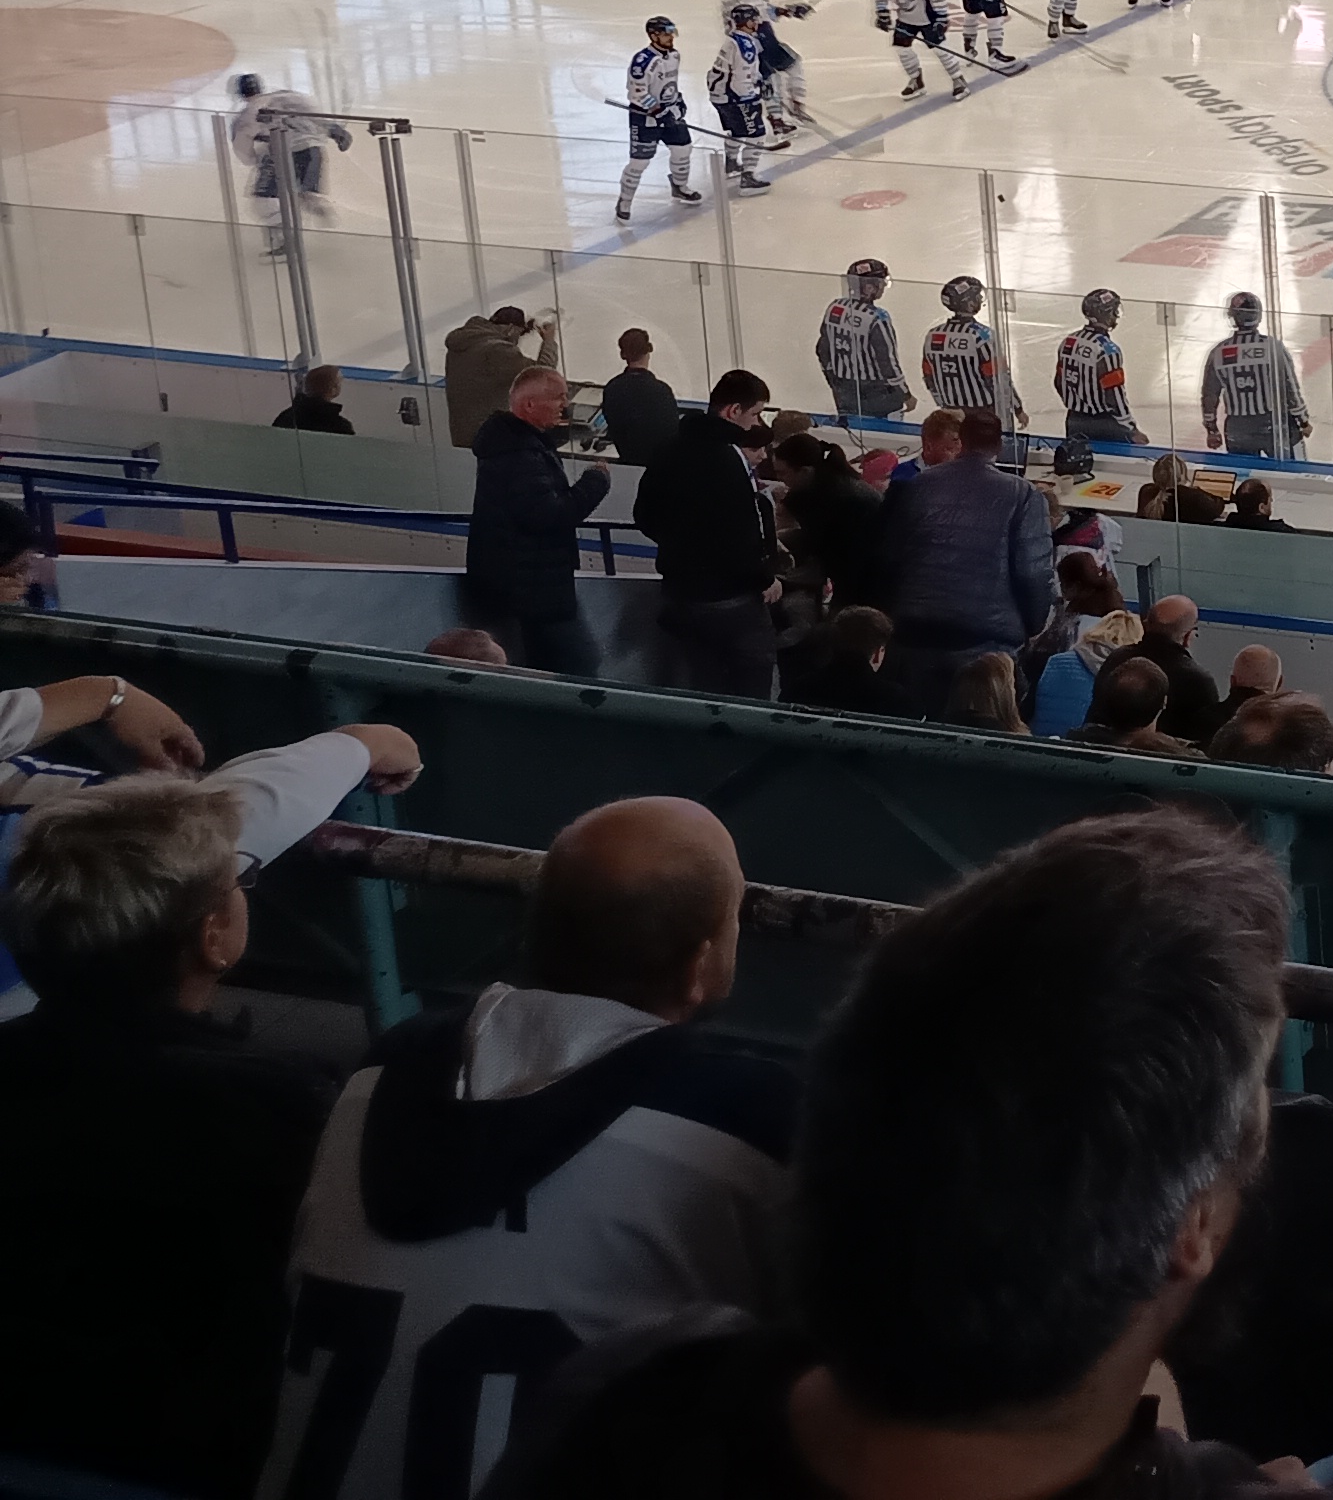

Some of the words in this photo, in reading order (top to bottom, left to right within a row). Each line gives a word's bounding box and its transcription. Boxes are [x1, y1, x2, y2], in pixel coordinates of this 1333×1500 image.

[1162, 74, 1243, 114] SPORT
[844, 312, 862, 328] KB
[948, 337, 968, 350] KB
[1074, 343, 1092, 359] KB
[1242, 347, 1265, 360] KB
[942, 361, 958, 375] 52
